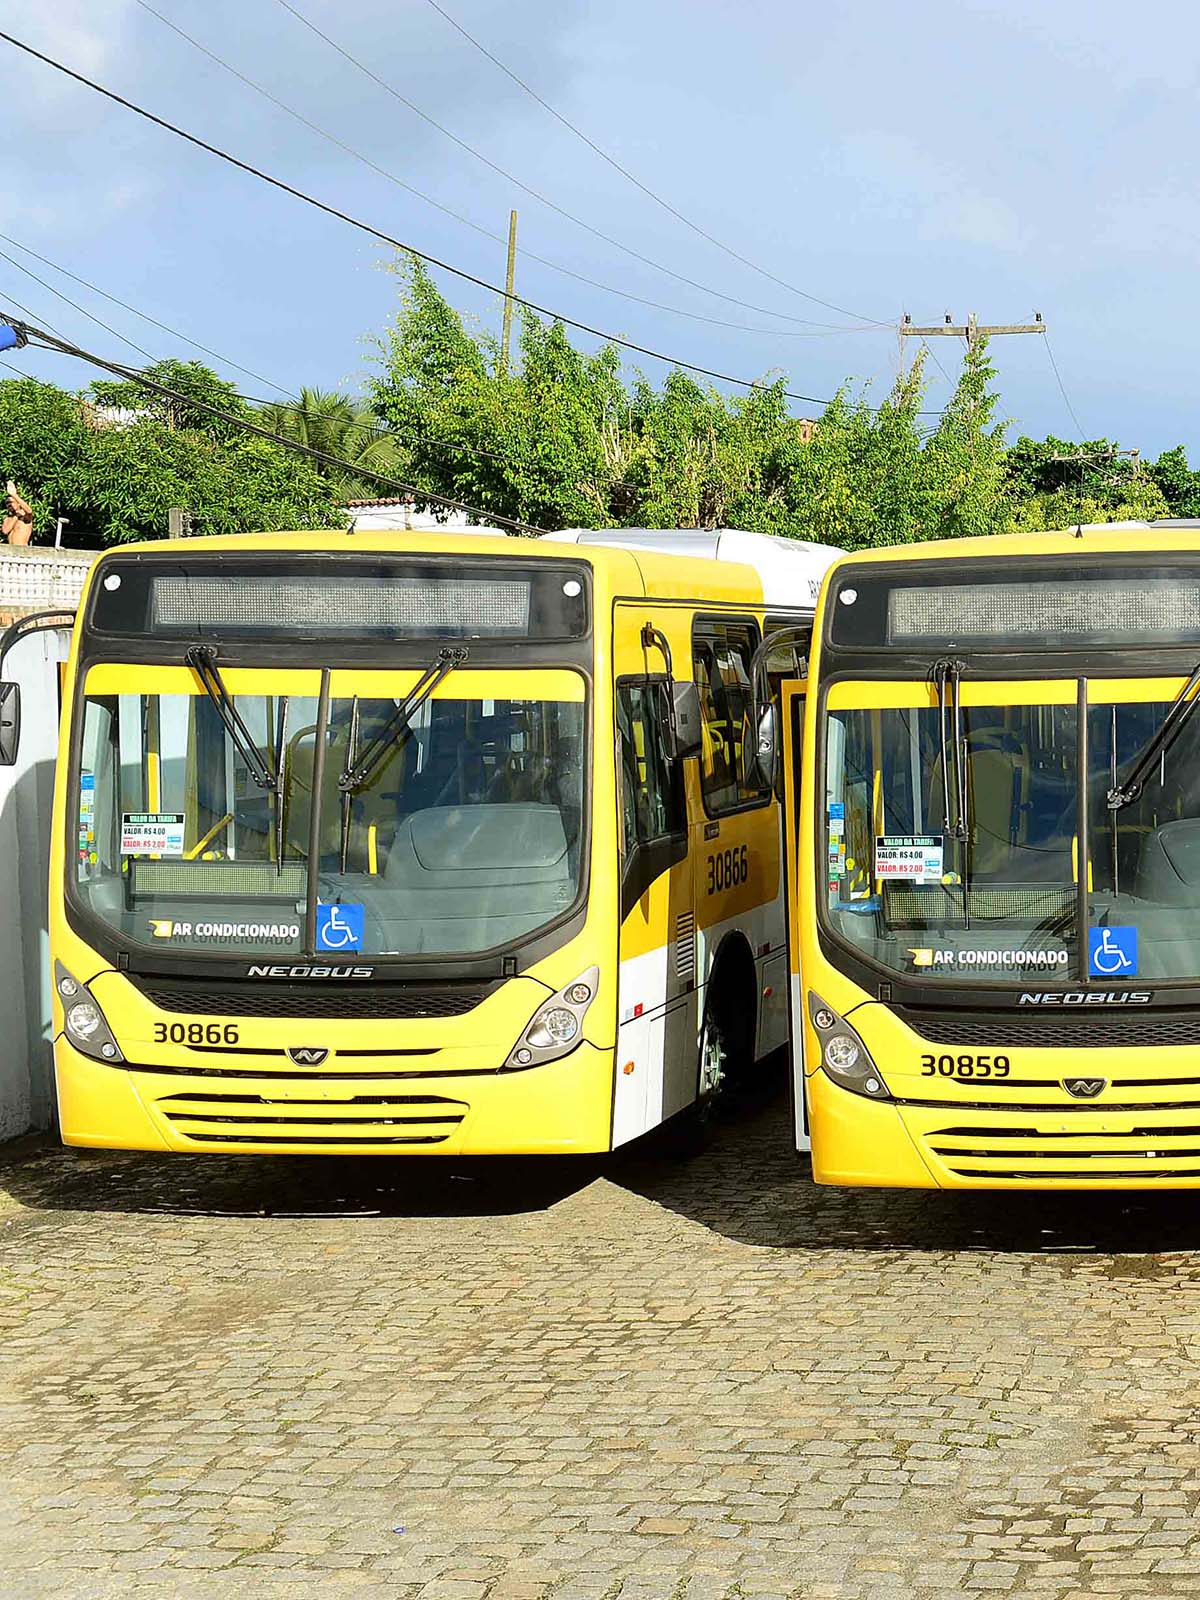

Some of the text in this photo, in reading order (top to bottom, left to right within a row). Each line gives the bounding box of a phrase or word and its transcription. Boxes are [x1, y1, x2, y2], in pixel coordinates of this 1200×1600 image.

[707, 844, 748, 896] 30866
[172, 922, 300, 938] AR CONDICIONADO
[934, 950, 1069, 965] AR CONDICIONADO
[247, 965, 375, 979] NEOBUS
[1018, 992, 1151, 1005] NEOBUS
[153, 1022, 239, 1044] 30866
[921, 1054, 1010, 1077] 30859
